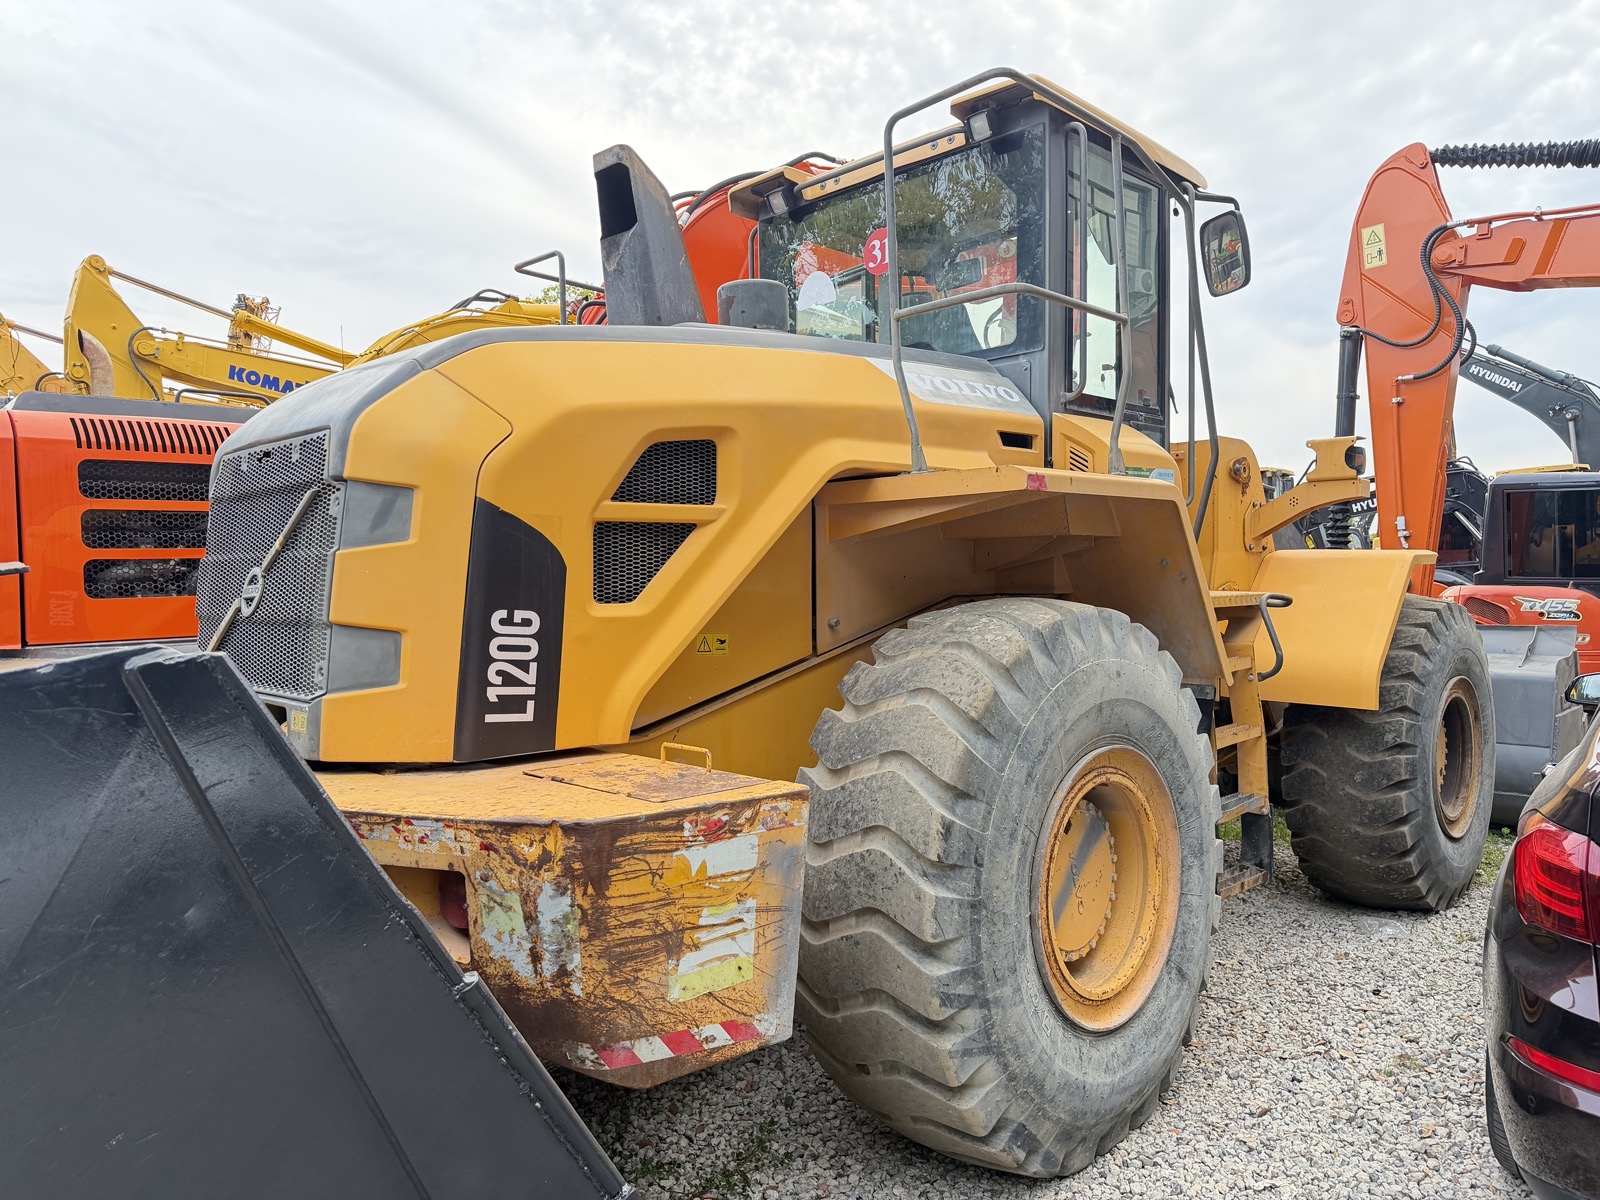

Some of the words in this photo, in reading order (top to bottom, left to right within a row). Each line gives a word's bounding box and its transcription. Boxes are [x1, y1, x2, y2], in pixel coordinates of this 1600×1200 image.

[228, 364, 311, 394] KOMA
[906, 372, 1021, 403] VOLVO
[1469, 364, 1523, 393] HYUNDAI
[1520, 599, 1580, 612] KX155
[484, 609, 541, 723] L120G
